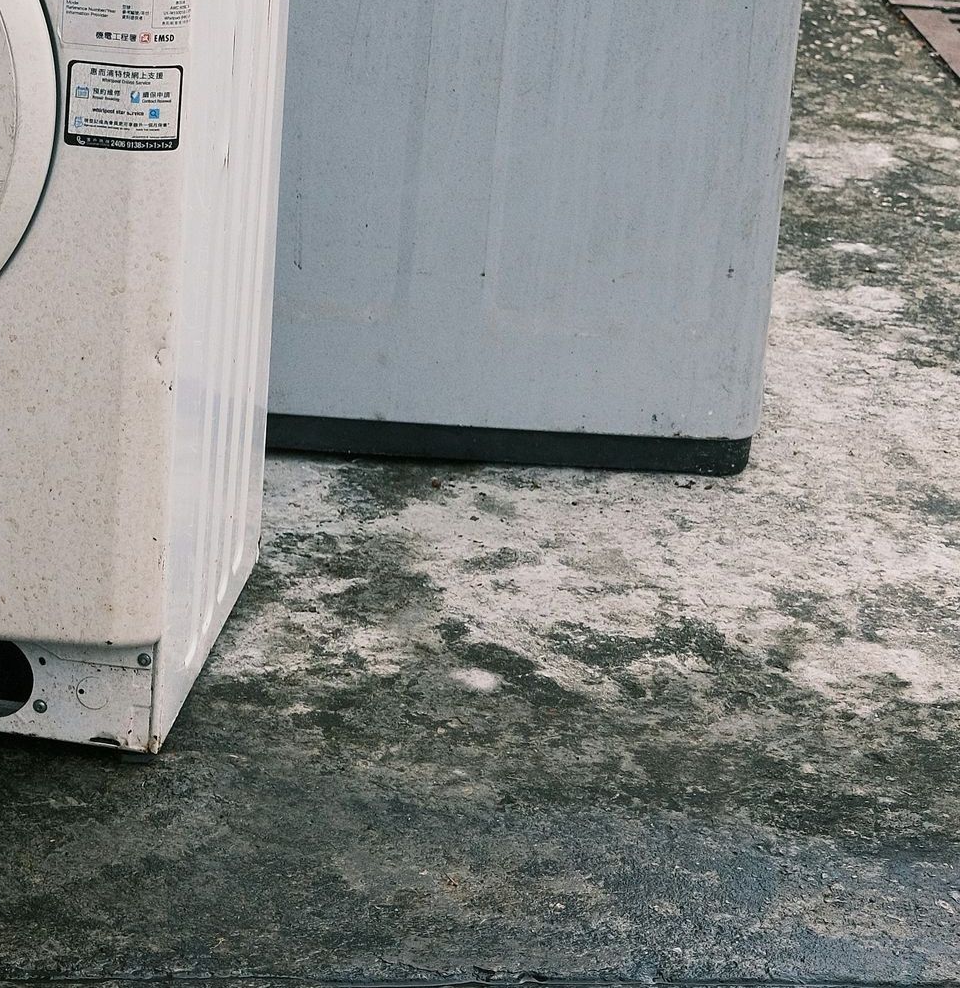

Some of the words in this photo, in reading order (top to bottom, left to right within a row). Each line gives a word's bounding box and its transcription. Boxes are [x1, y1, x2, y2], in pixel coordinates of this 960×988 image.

[154, 34, 175, 42] EMSD
[90, 67, 164, 80] 惠而浦特快網上支援
[110, 139, 126, 148] 2406
